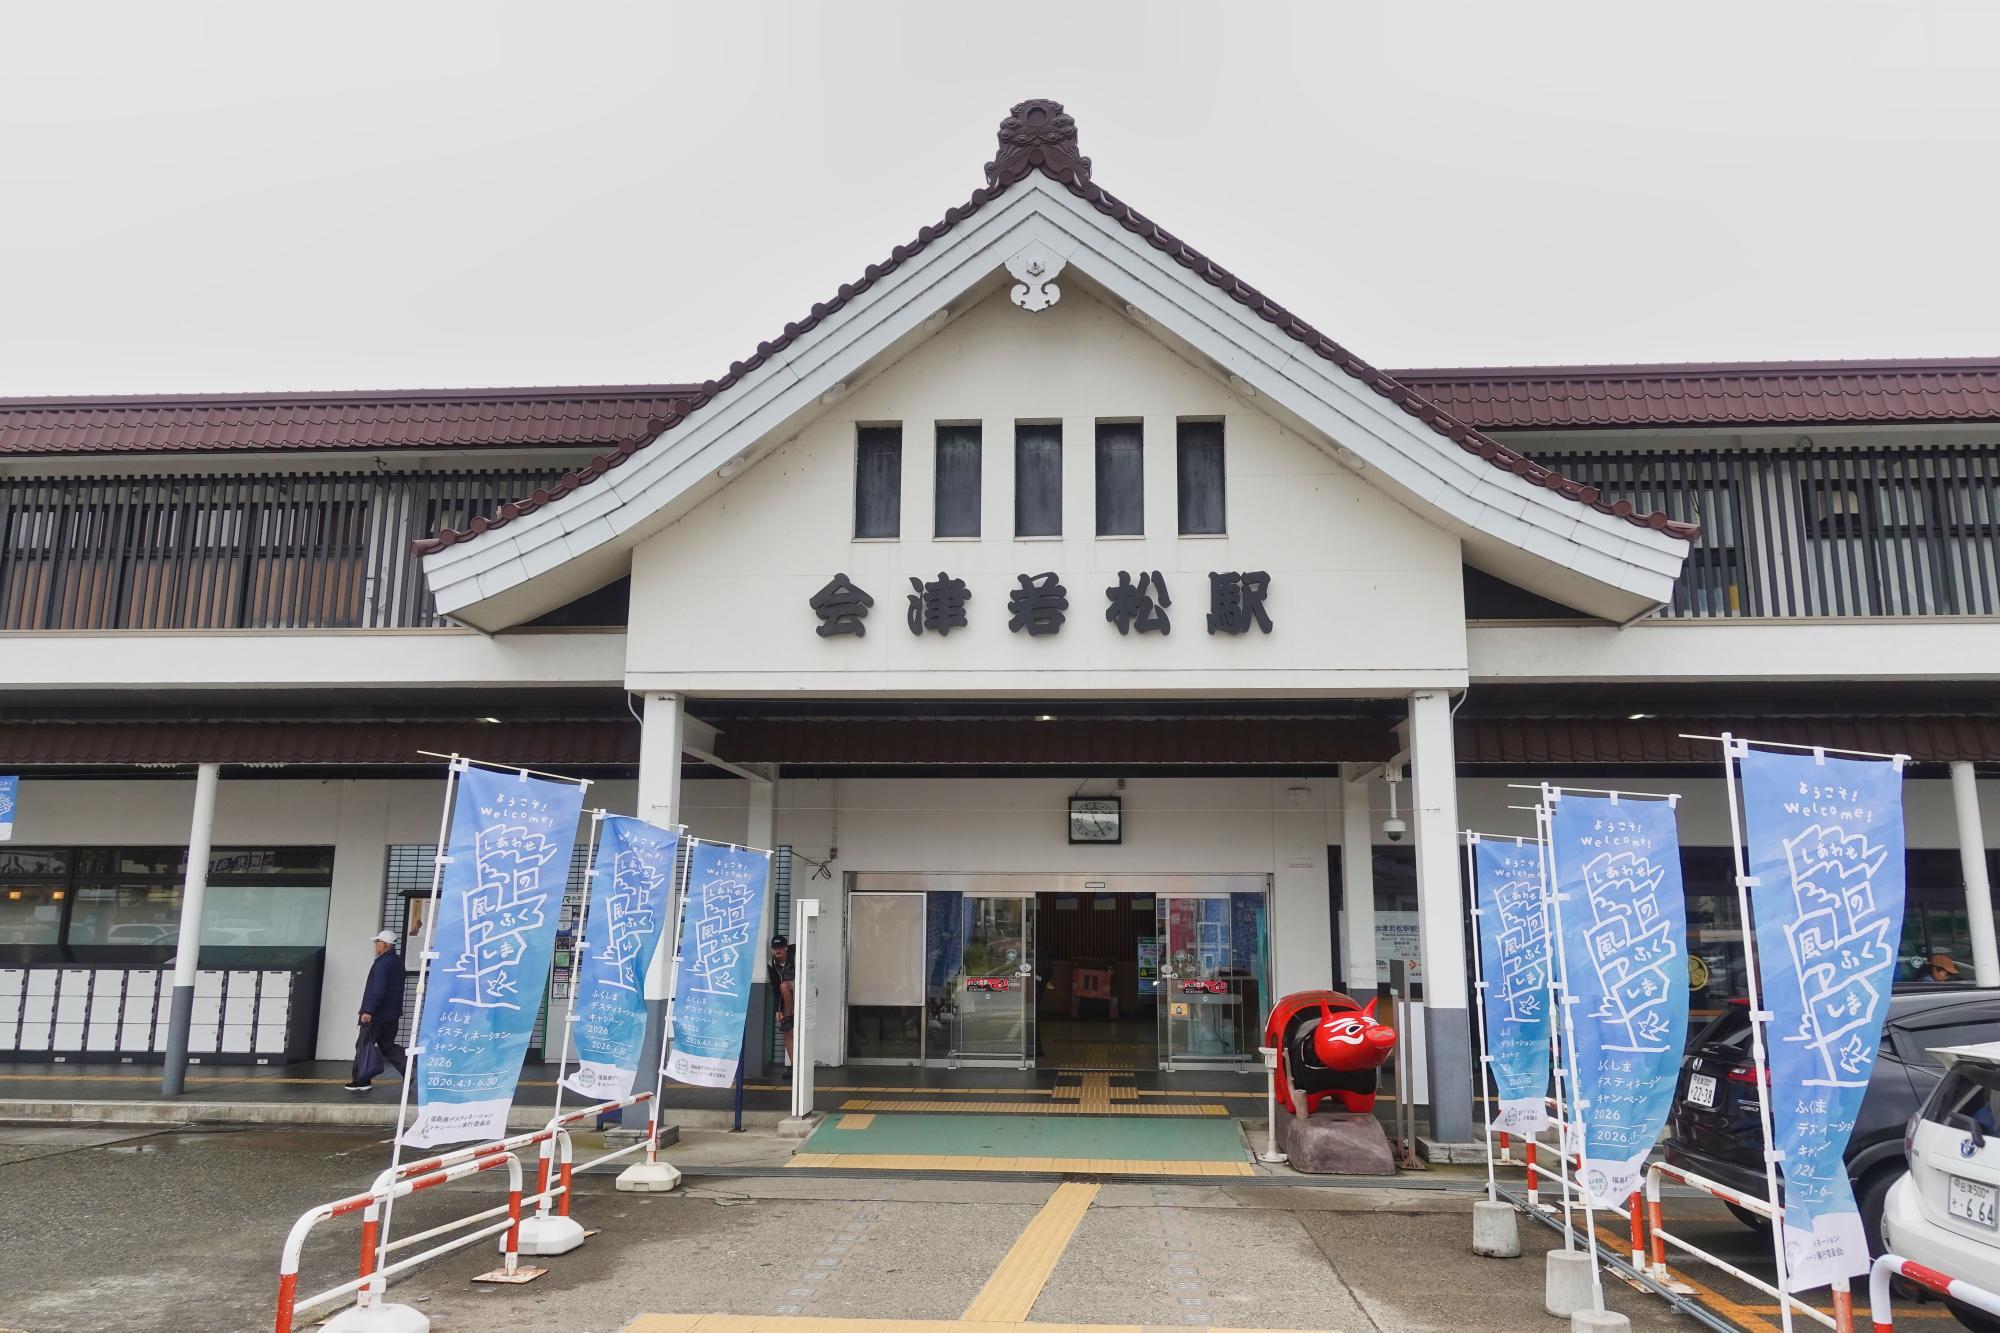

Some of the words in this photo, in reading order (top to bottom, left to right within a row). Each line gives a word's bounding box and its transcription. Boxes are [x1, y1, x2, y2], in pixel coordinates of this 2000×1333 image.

[809, 570, 1273, 638] 会津若松駅
[1799, 781, 1858, 802] ようこそ!
[480, 807, 554, 828] Welcome!
[1784, 802, 1873, 822] Welcome!
[484, 837, 537, 851] しあわせ
[1581, 836, 1650, 849] Welcome!
[1802, 842, 1858, 864] しあわせ
[519, 875, 531, 888] の
[1593, 865, 1647, 883] しあわせ
[472, 895, 496, 920] 風
[1641, 903, 1652, 917] の
[1850, 894, 1863, 911] の
[500, 908, 528, 926] ふく
[483, 941, 515, 960] しま
[1597, 931, 1625, 961] 風
[1634, 939, 1662, 961] ふく
[1798, 926, 1834, 965] 風
[1841, 941, 1874, 969] ふく
[1626, 978, 1658, 999] しま
[1826, 990, 1862, 1018] しま
[587, 1024, 609, 1035] 2026
[427, 1057, 453, 1068] 2026
[1594, 1107, 1621, 1121] 2026
